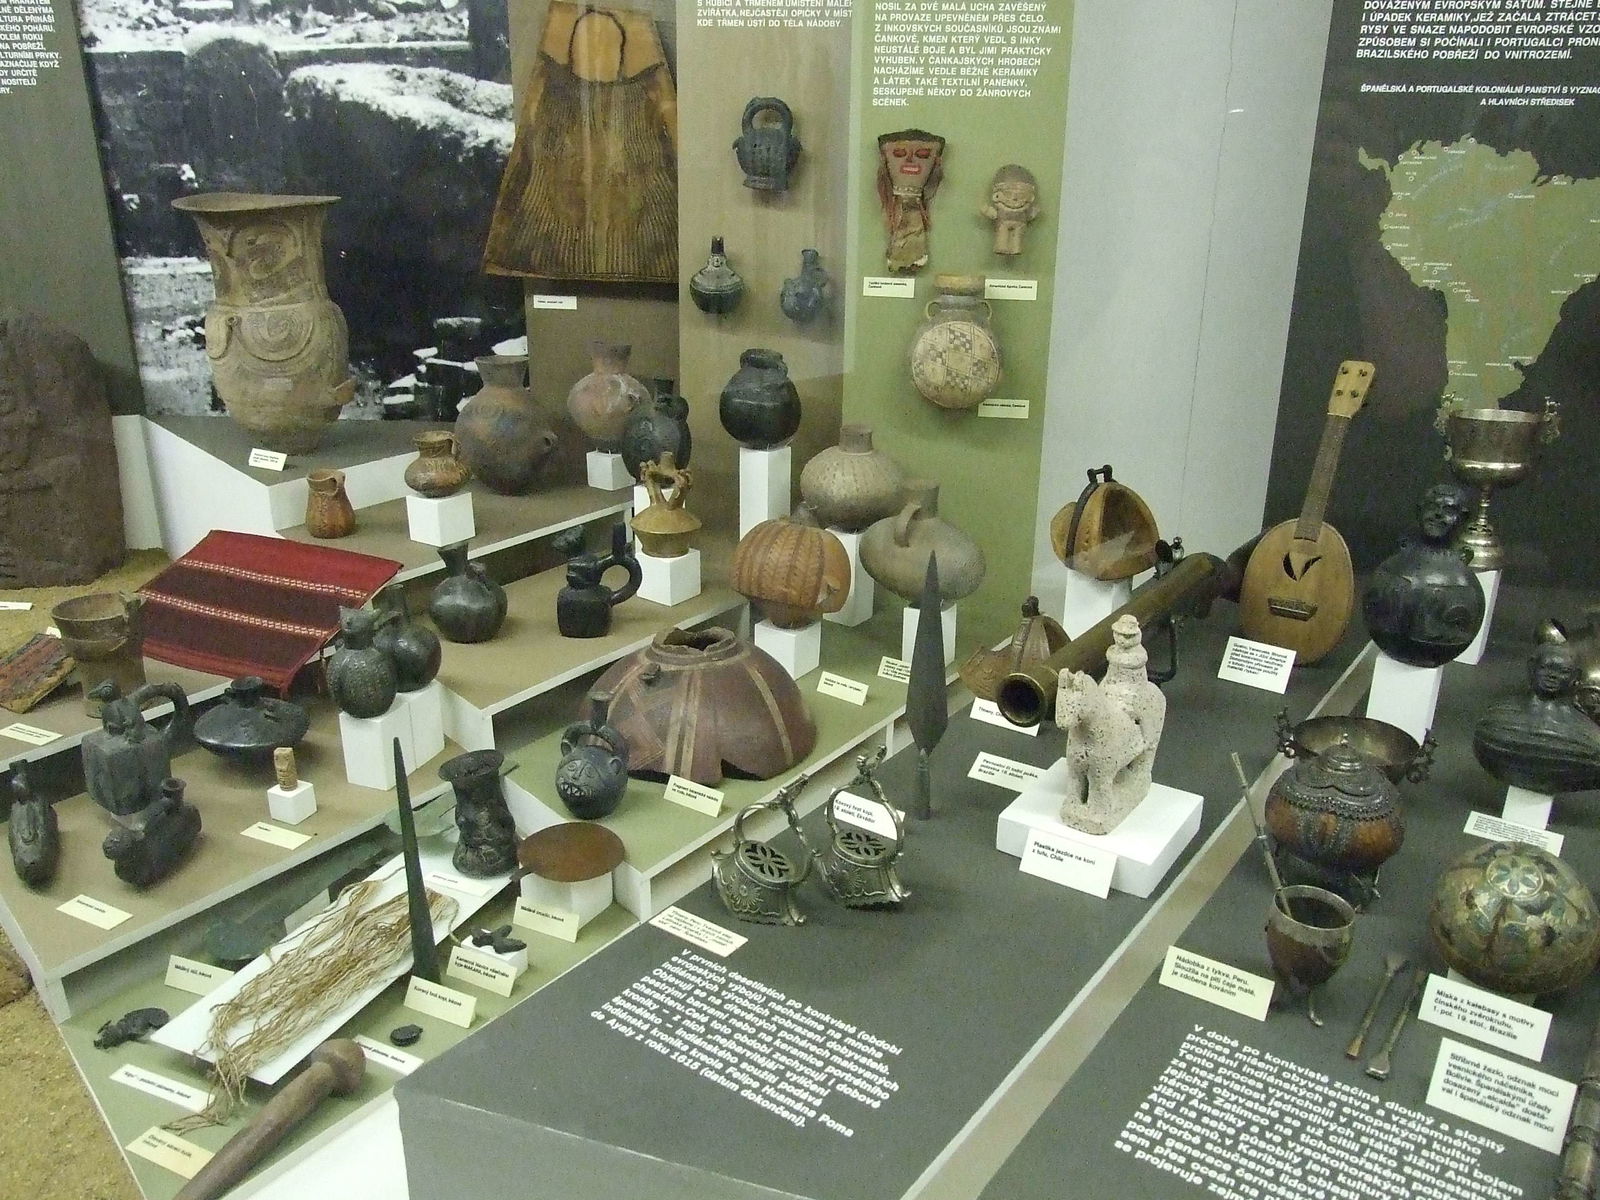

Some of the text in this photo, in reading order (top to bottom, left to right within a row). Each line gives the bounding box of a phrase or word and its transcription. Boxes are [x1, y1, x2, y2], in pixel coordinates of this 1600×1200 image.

[875, 2, 901, 10] NOSIL
[905, 2, 917, 10] ZA
[920, 1, 938, 10] DVĚ
[970, 3, 995, 11] UCHA
[992, 13, 1015, 22] PŘES
[1019, 13, 1046, 22] ČELO.
[1369, 11, 1412, 22] ÚPADEK
[1497, 11, 1541, 22] ZAČALA
[1545, 10, 1596, 21] ZTRÁCET
[697, 18, 713, 26] KDE
[784, 18, 803, 27] TĚLA
[875, 24, 880, 32] Z
[1032, 24, 1062, 34] ZNÁMI
[1360, 23, 1574, 34] RYSY VE SNAZE NAPODOBIT EVROPSKÉ
[923, 35, 948, 43] KMEN
[951, 34, 980, 43] KTERÝ
[984, 36, 1006, 44] VEDL
[1010, 36, 1016, 44] S
[1020, 36, 1041, 44] INKY
[1358, 36, 1416, 46] ZPŮSOBEM
[1420, 38, 1430, 46] SI
[1434, 36, 1484, 46] POČÍNALI
[1494, 38, 1564, 46] PORTUGALCI
[874, 44, 920, 54] NEUSTÁLÉ
[923, 46, 946, 54] BOJE
[949, 46, 955, 54] A
[959, 46, 976, 54] BYL
[1001, 47, 1052, 55] PRAKTICKY
[1356, 48, 1573, 59] BRAZILSKÉHO POBŘEŽÍ DO VNITROZEMÍ.
[998, 58, 1041, 66] HROBECH
[874, 66, 1038, 76] NACHÁZÍME VEDLE BĚŽNÉ KERAMIKY
[883, 75, 911, 85] LÁTEK
[915, 77, 938, 86] TAKÉ
[941, 77, 980, 86] TEXTILNÍ
[873, 87, 924, 96] SESKUPENÉ
[927, 87, 956, 96] NĚKDY
[1415, 84, 1474, 93] PORTUGALSKÉ
[1475, 84, 1524, 94] KOLONIÁLNÍ
[1524, 85, 1560, 94] PANSTVÍ
[1562, 86, 1568, 94] S
[1480, 98, 1575, 106] A HLAVNÍCH STŘEDISEK
[1049, 853, 1064, 862] Chile
[681, 948, 692, 956] V
[785, 999, 802, 1009] po
[693, 988, 707, 998] se
[707, 995, 722, 1005] na
[1436, 989, 1458, 1001] Miska
[1508, 1015, 1534, 1028] motivy
[685, 996, 756, 1034] barvami nebo
[709, 1019, 732, 1034] toto
[826, 1028, 883, 1059] na mnoha
[1185, 1033, 1230, 1055] proces
[1194, 1024, 1260, 1056] V době po
[590, 1010, 739, 1091] de Ayaly roku 1615 (datum
[1178, 1048, 1214, 1069] Tento
[649, 1027, 689, 1052] kronika
[688, 1047, 724, 1070] kreola
[724, 1066, 760, 1088] Felipe
[818, 1114, 854, 1137] Poma
[776, 1081, 823, 1107] podává
[1538, 1086, 1559, 1097] moci
[1188, 1098, 1246, 1128] Ameriky
[1147, 1092, 1330, 1176] And sebe jen
[1164, 1137, 1232, 1171] generace
